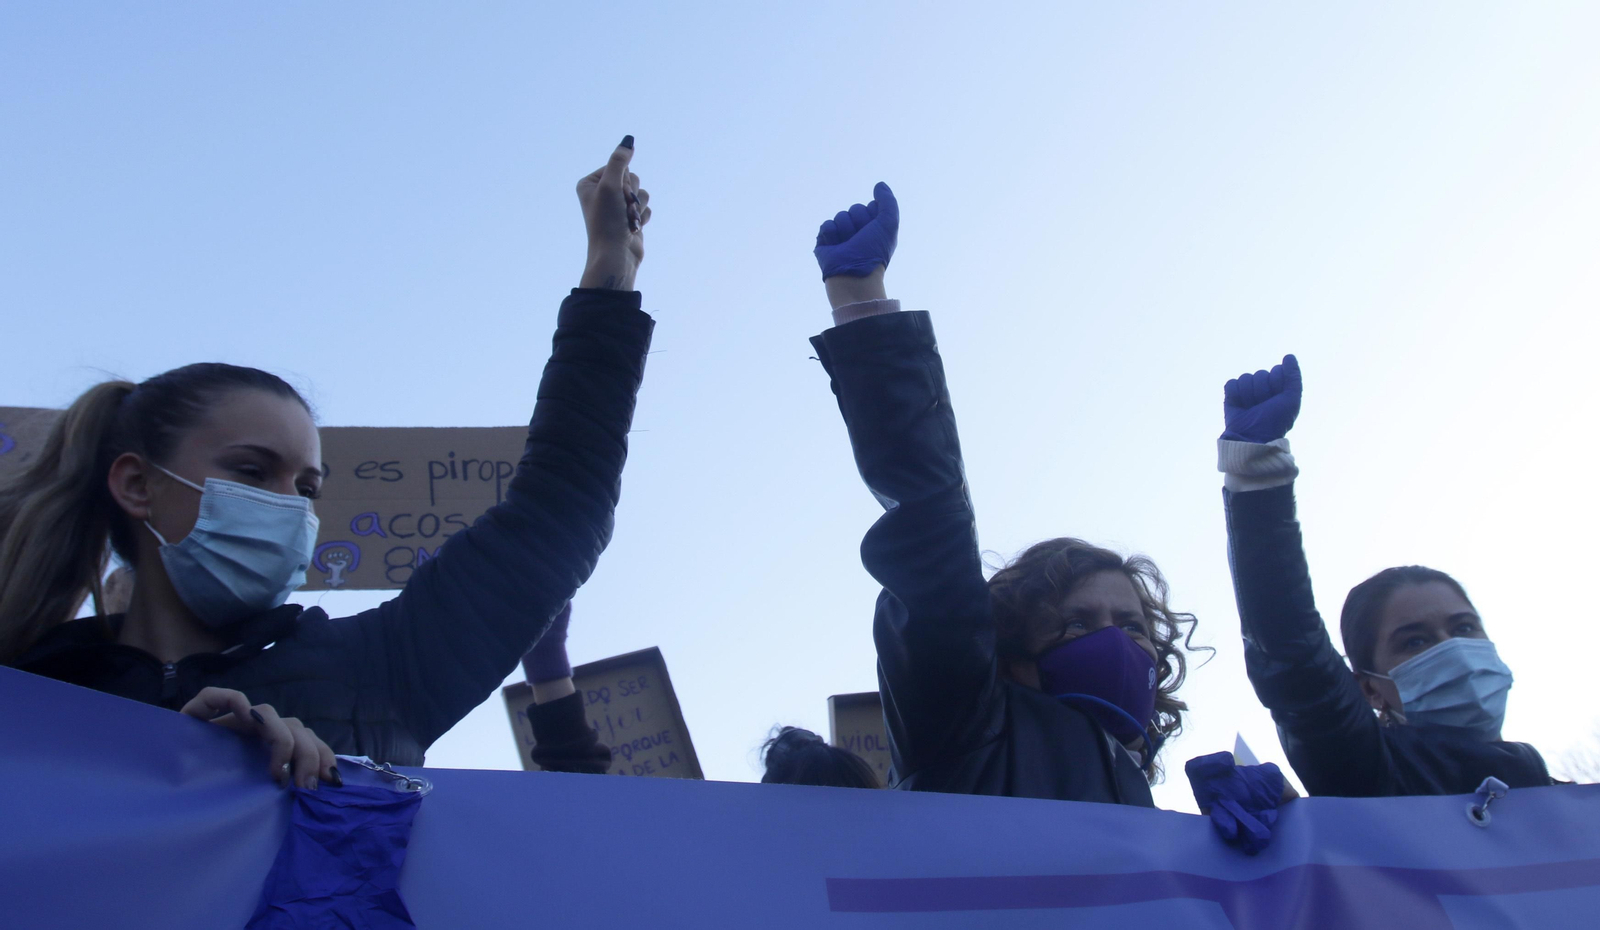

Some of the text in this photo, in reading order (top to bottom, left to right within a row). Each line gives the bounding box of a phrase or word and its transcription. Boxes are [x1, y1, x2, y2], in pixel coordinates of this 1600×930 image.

[354, 460, 404, 483] es
[428, 450, 515, 507] pirop
[350, 511, 470, 539] acos
[617, 675, 650, 697] SER
[611, 729, 672, 762] PORQUE
[841, 731, 888, 753] VIOL
[631, 751, 680, 777] DE LA
